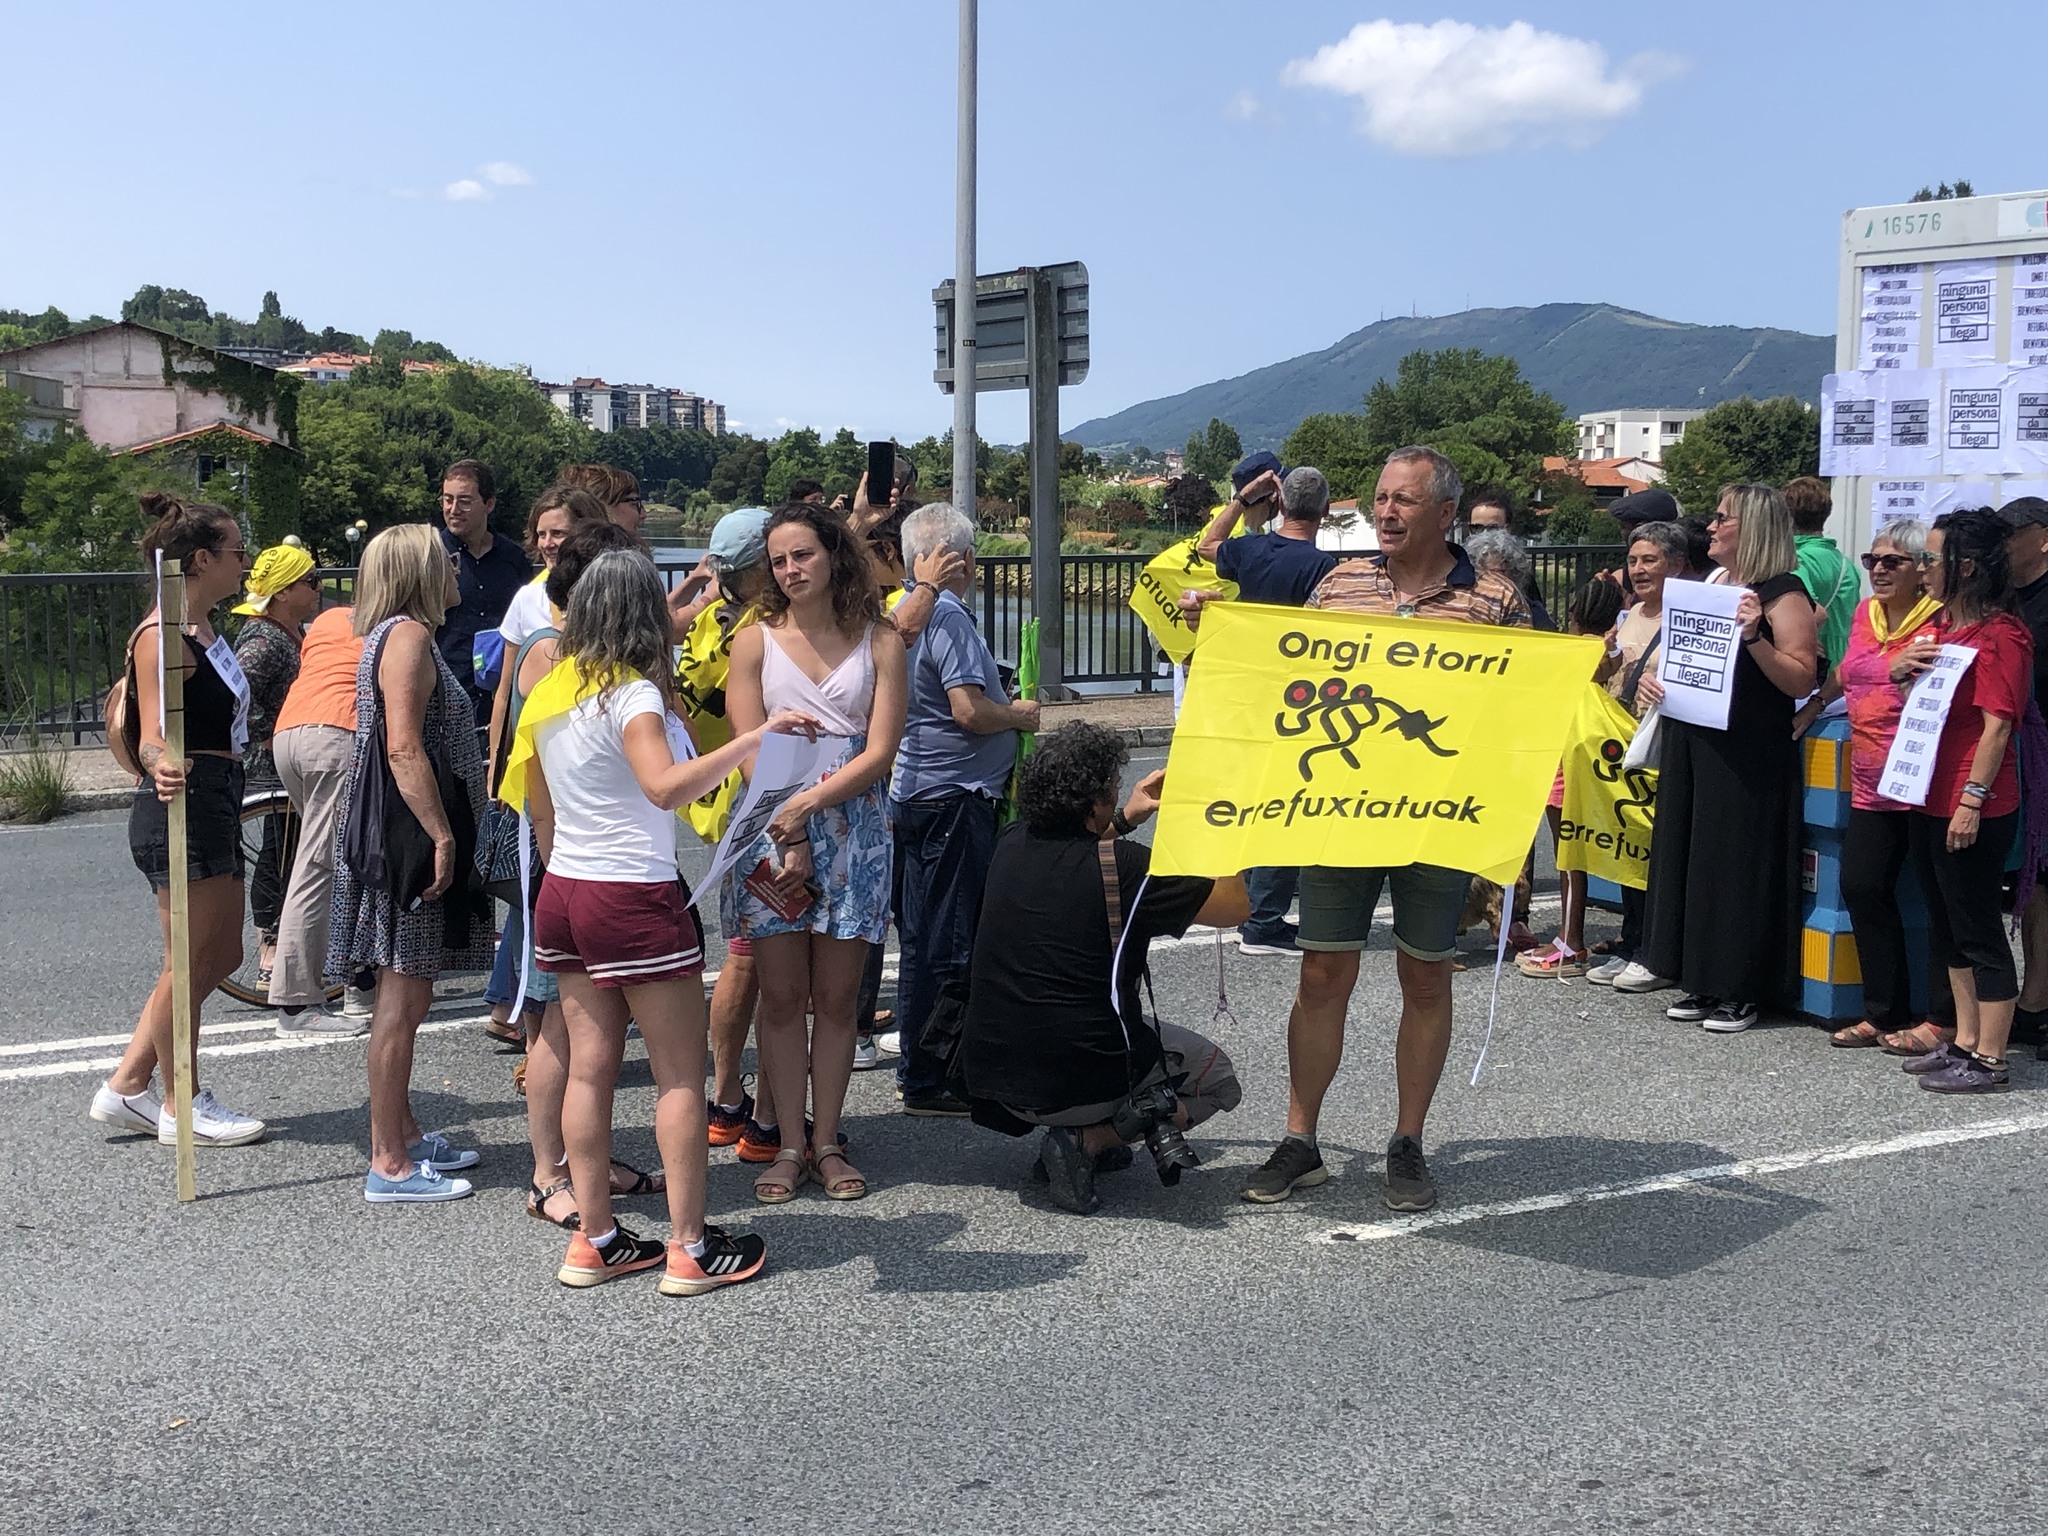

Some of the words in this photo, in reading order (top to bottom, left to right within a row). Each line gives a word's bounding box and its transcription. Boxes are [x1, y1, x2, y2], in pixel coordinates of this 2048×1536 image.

[1884, 212, 1942, 236] 16576
[1942, 283, 1987, 300] ninguna
[1942, 300, 1987, 316] persona
[1950, 317, 1961, 325] es
[1950, 326, 1978, 341] ilegal
[1953, 391, 1998, 407] ninguna
[2020, 396, 2040, 405] inor
[1952, 408, 1998, 422] persona
[1961, 423, 1971, 431] es
[2027, 419, 2039, 428] da
[1961, 433, 1989, 448] ilegal
[1673, 612, 1732, 635] ninguna
[1278, 631, 1373, 672] Ongi
[1672, 633, 1727, 655] persona
[1681, 653, 1693, 663] es
[1677, 664, 1712, 687] ilegal
[1204, 788, 1486, 828] errefuxiatuak
